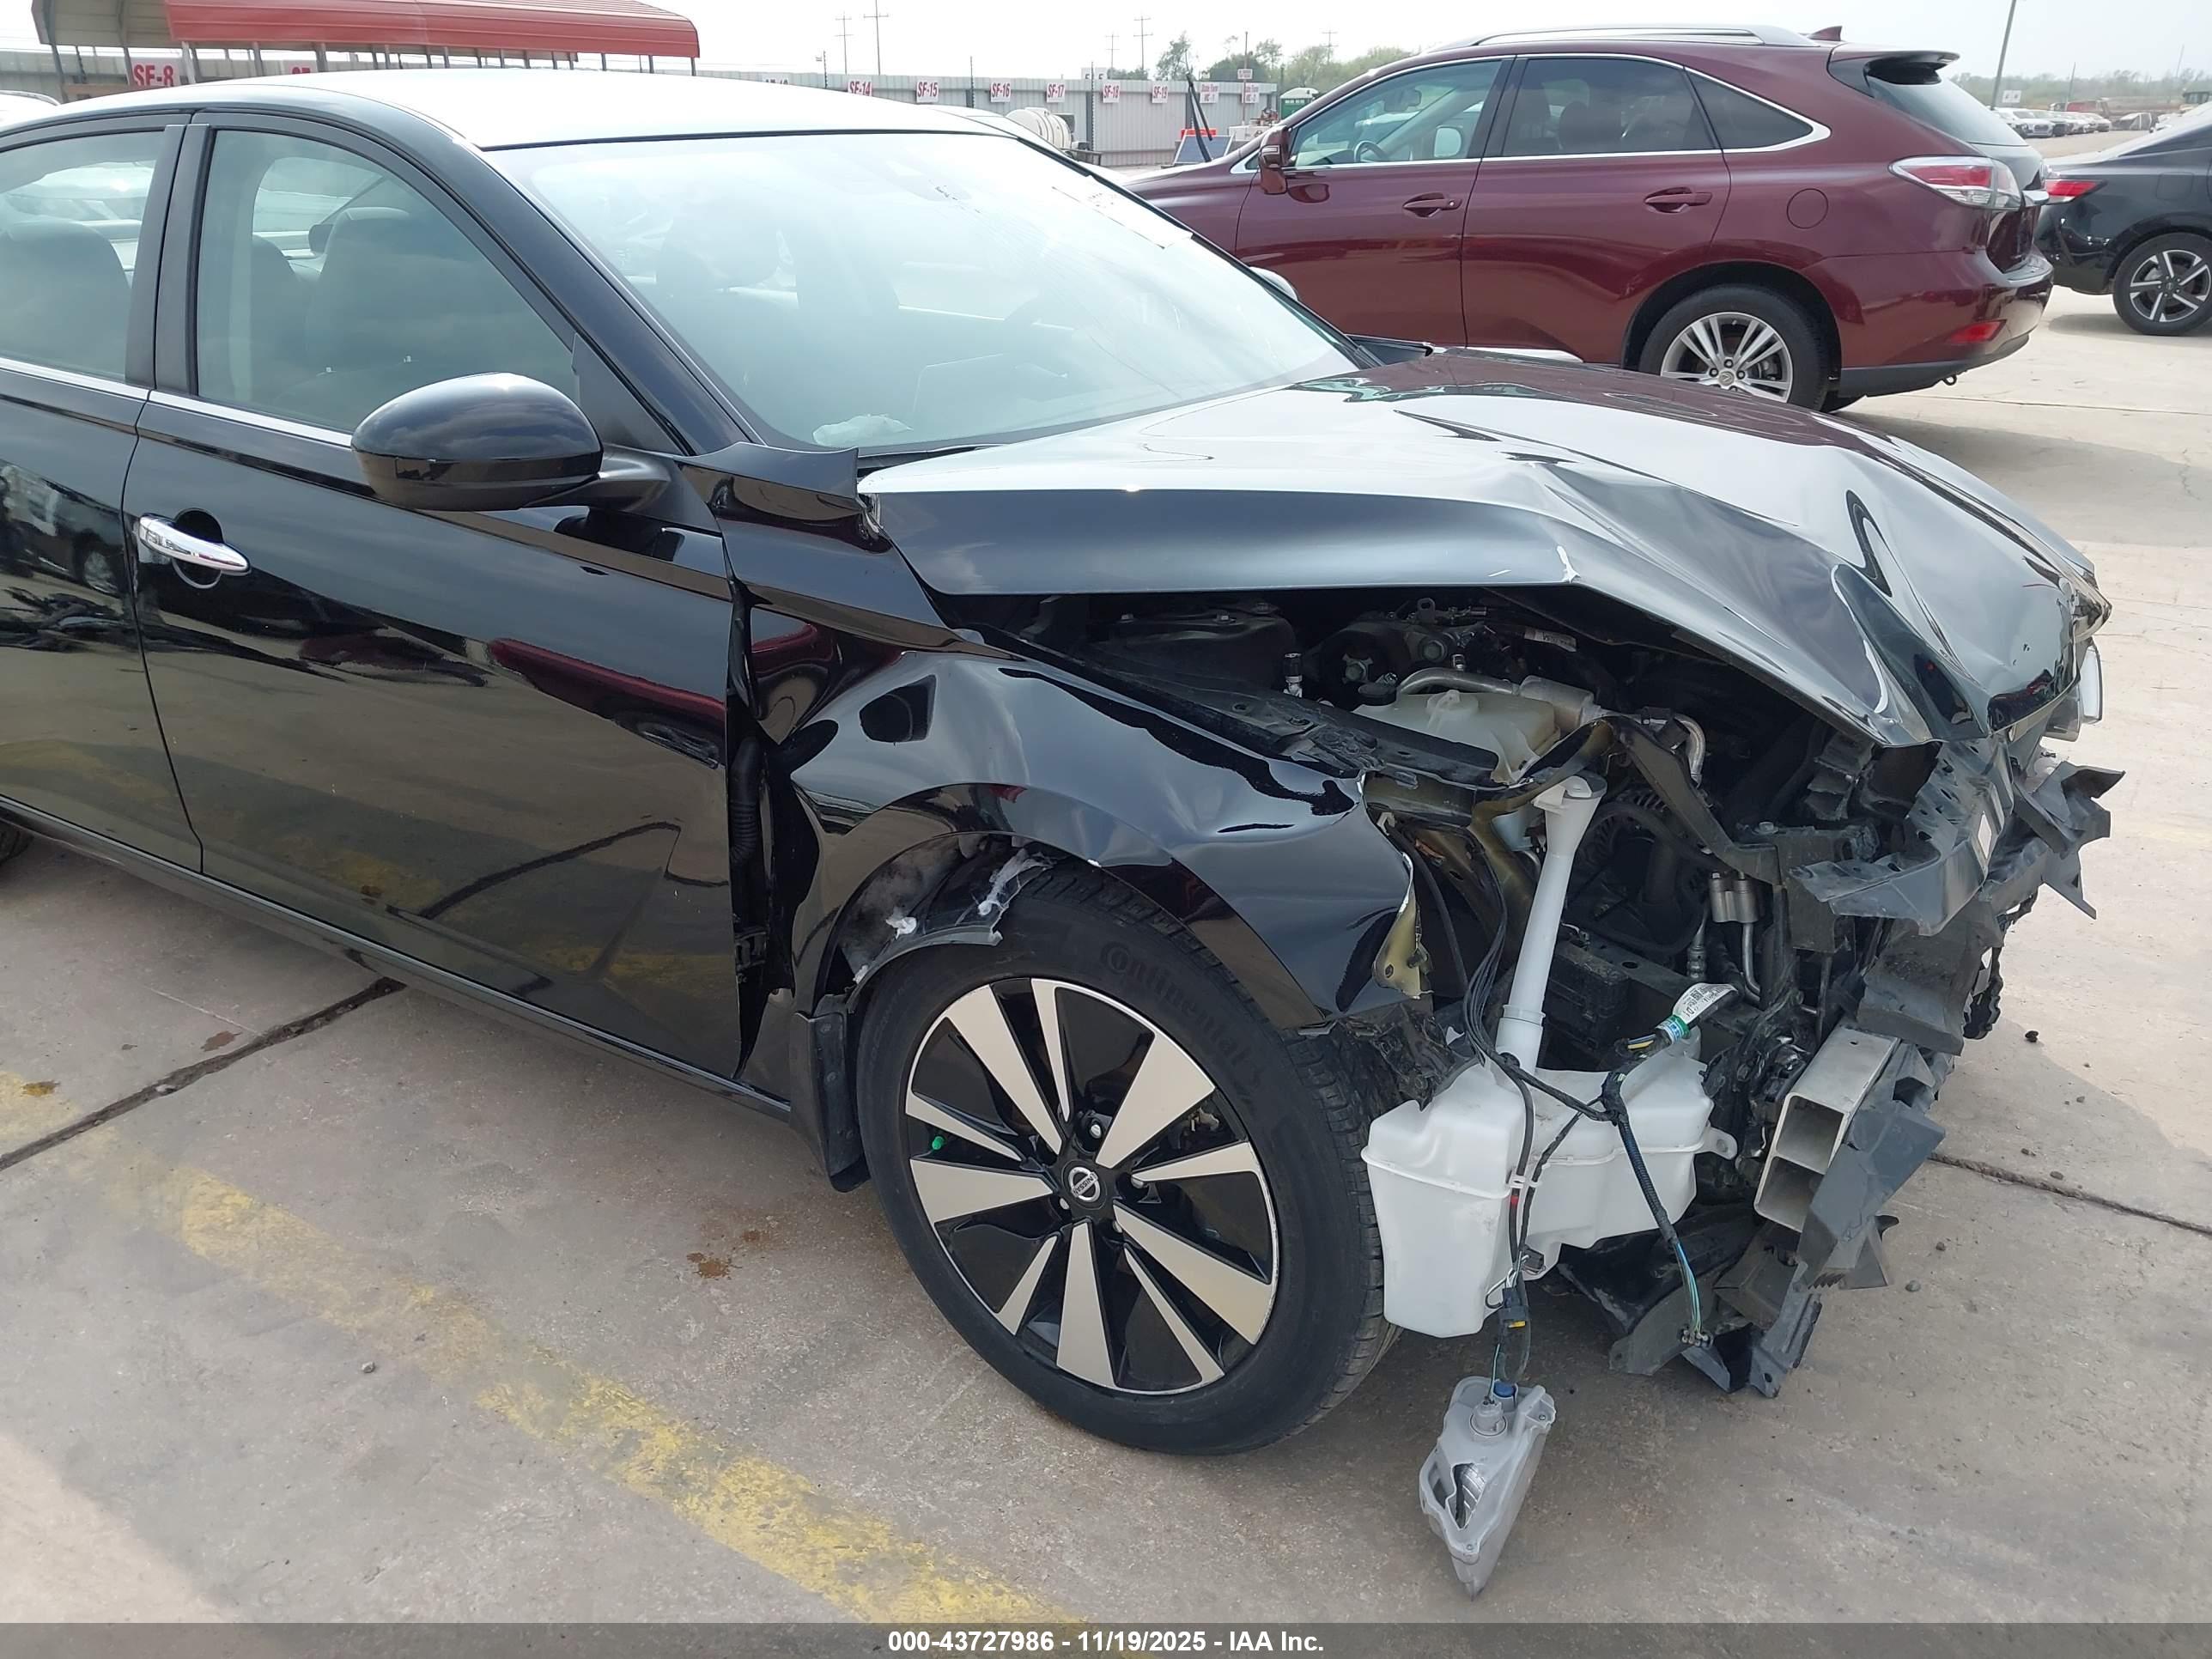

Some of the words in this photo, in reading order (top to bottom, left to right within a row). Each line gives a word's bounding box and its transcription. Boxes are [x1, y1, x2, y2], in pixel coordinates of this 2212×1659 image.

[133, 64, 174, 87] SF-8
[849, 81, 872, 96] SF-14
[917, 82, 939, 97] SF-15
[991, 83, 1011, 98] SF-16
[1046, 84, 1065, 98] SF-17
[1103, 85, 1120, 99] SF-18
[1153, 86, 1168, 99] SF-19
[1073, 1176, 1095, 1194] NISSAN
